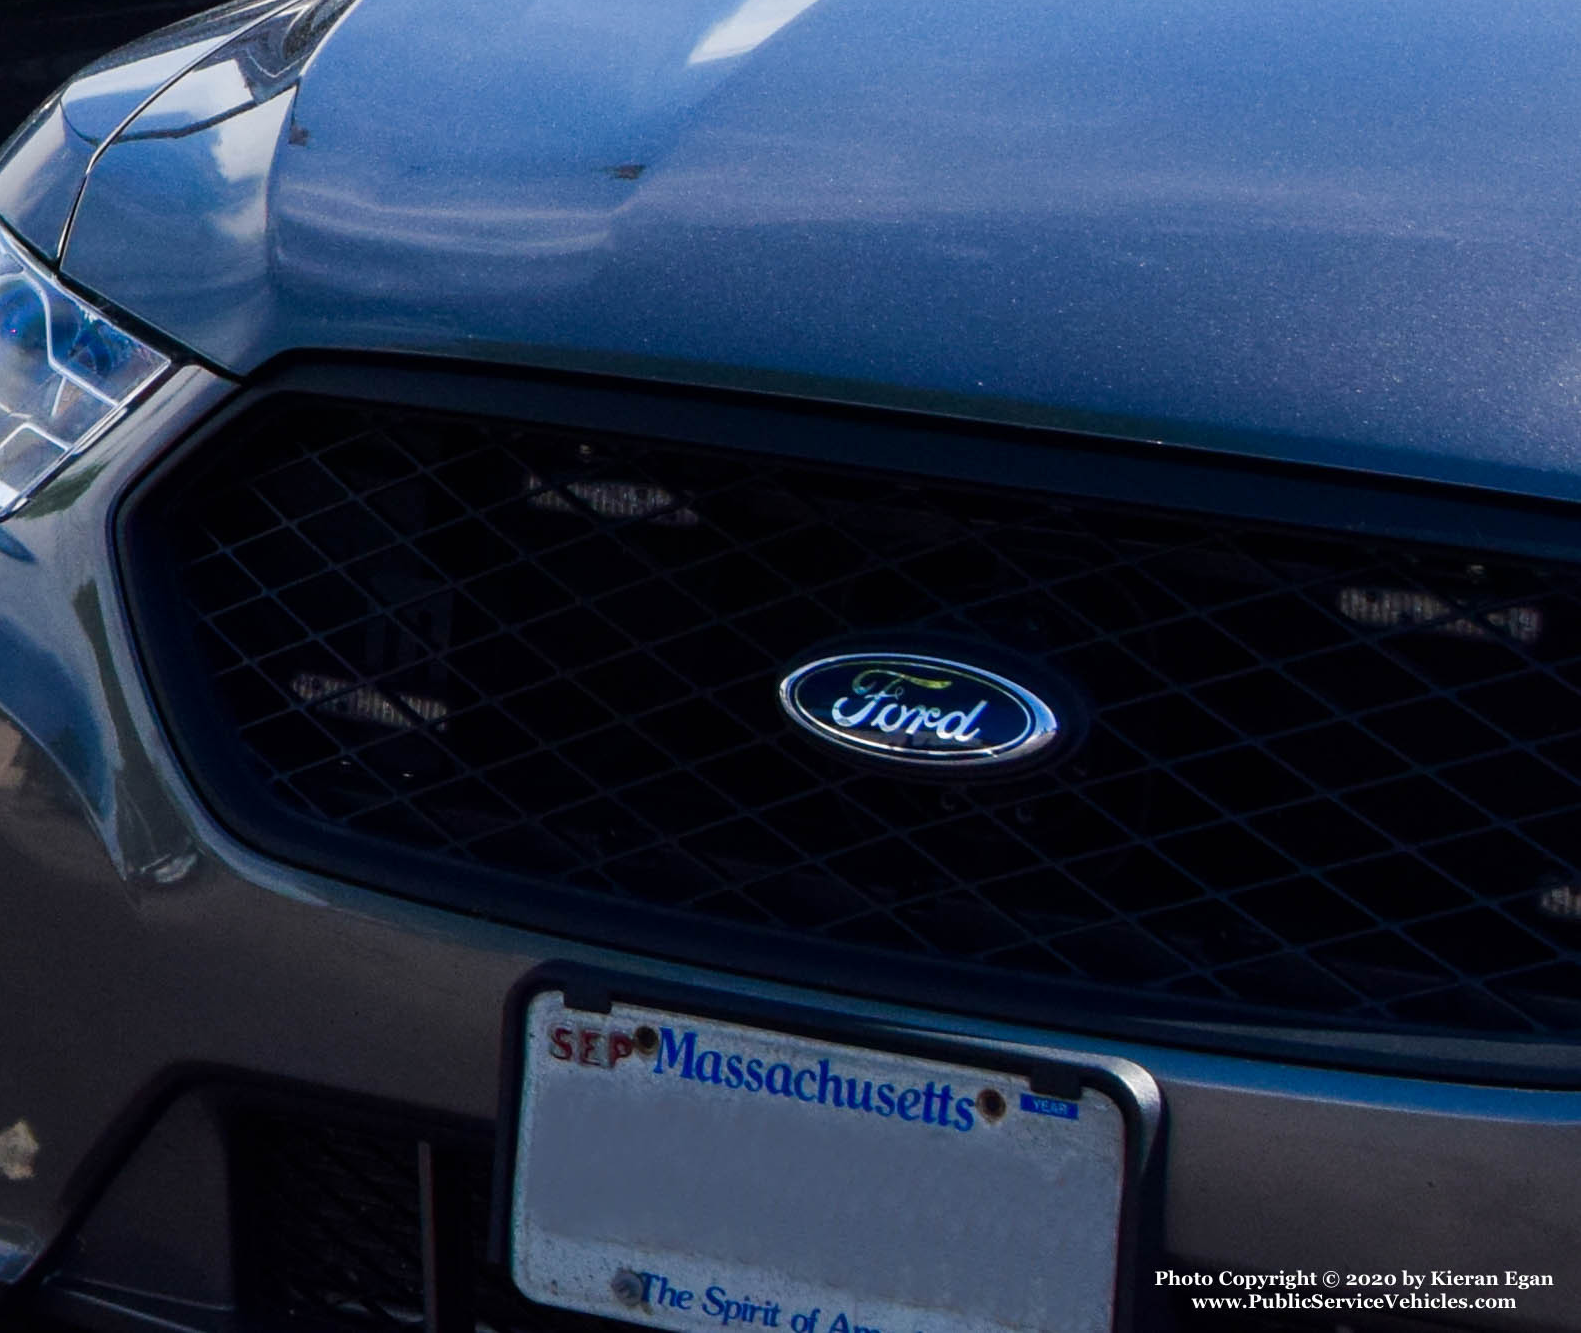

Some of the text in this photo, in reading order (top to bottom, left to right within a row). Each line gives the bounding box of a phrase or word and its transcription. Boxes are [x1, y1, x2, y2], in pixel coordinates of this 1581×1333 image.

[831, 669, 988, 742] Ford
[550, 1027, 976, 1133] SEP Massachusetts
[639, 1271, 694, 1311] The
[701, 1285, 782, 1327] Spirit
[790, 1307, 821, 1333] of
